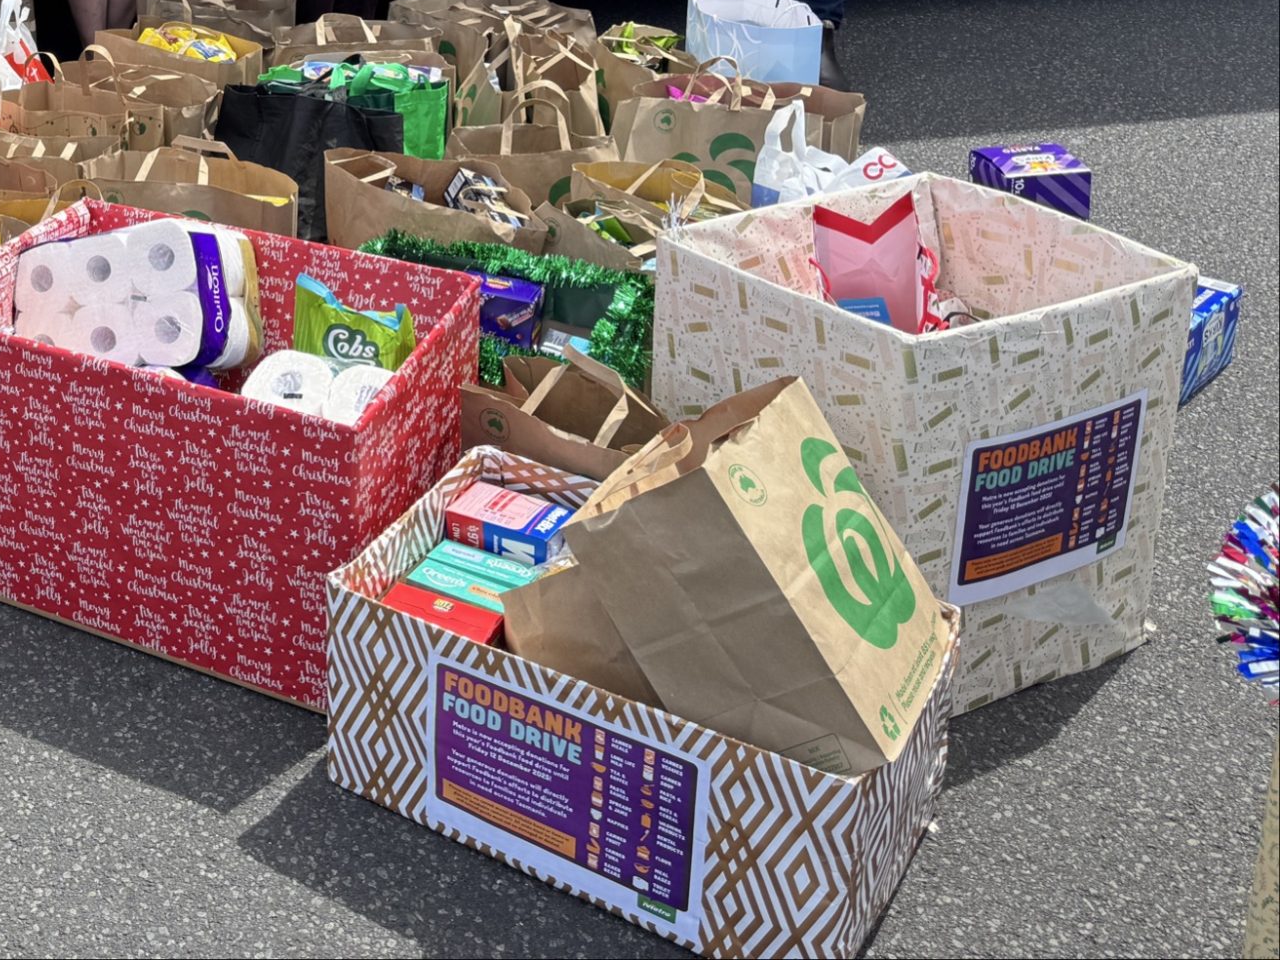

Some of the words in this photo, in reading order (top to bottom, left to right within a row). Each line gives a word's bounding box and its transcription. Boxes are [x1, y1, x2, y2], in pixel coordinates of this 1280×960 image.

[213, 264, 225, 334] Quilton
[328, 327, 377, 363] Cobs
[974, 465, 1022, 493] FOOD
[1027, 447, 1076, 481] DRIVE
[978, 426, 1079, 473] FOODBANK
[442, 692, 502, 731] FOOD
[510, 719, 583, 765] DRIVE
[444, 670, 583, 745] FOODBANK
